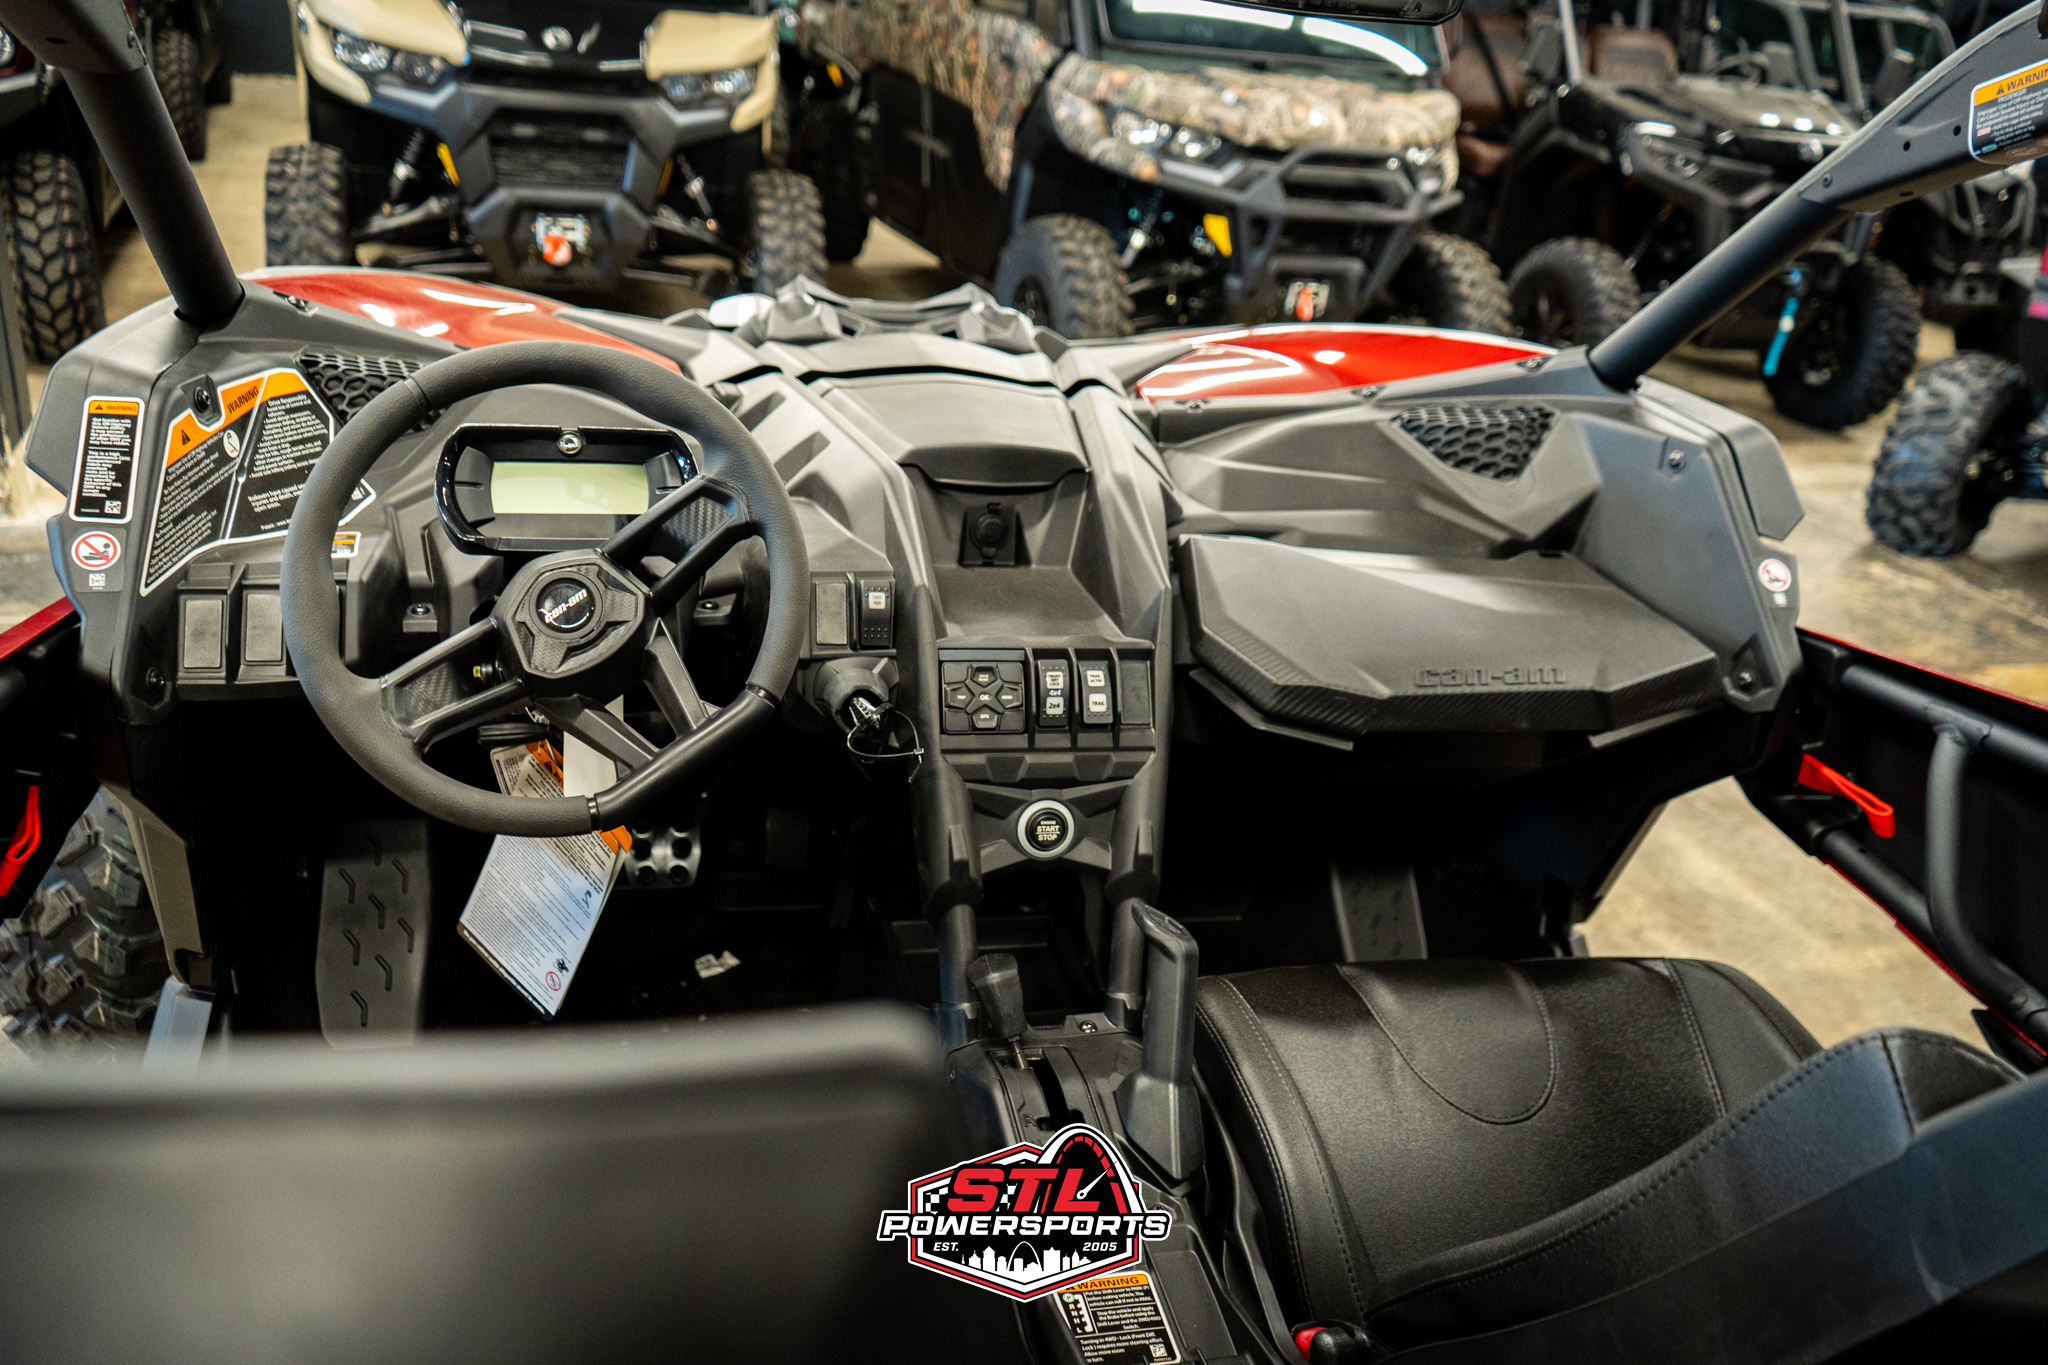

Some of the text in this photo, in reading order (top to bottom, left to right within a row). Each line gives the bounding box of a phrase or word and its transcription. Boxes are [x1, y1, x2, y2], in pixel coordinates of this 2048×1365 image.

[227, 386, 260, 414] WARNING
[545, 588, 588, 624] can-am
[1415, 667, 1567, 687] can-am
[1077, 1277, 1140, 1291] WARNING
